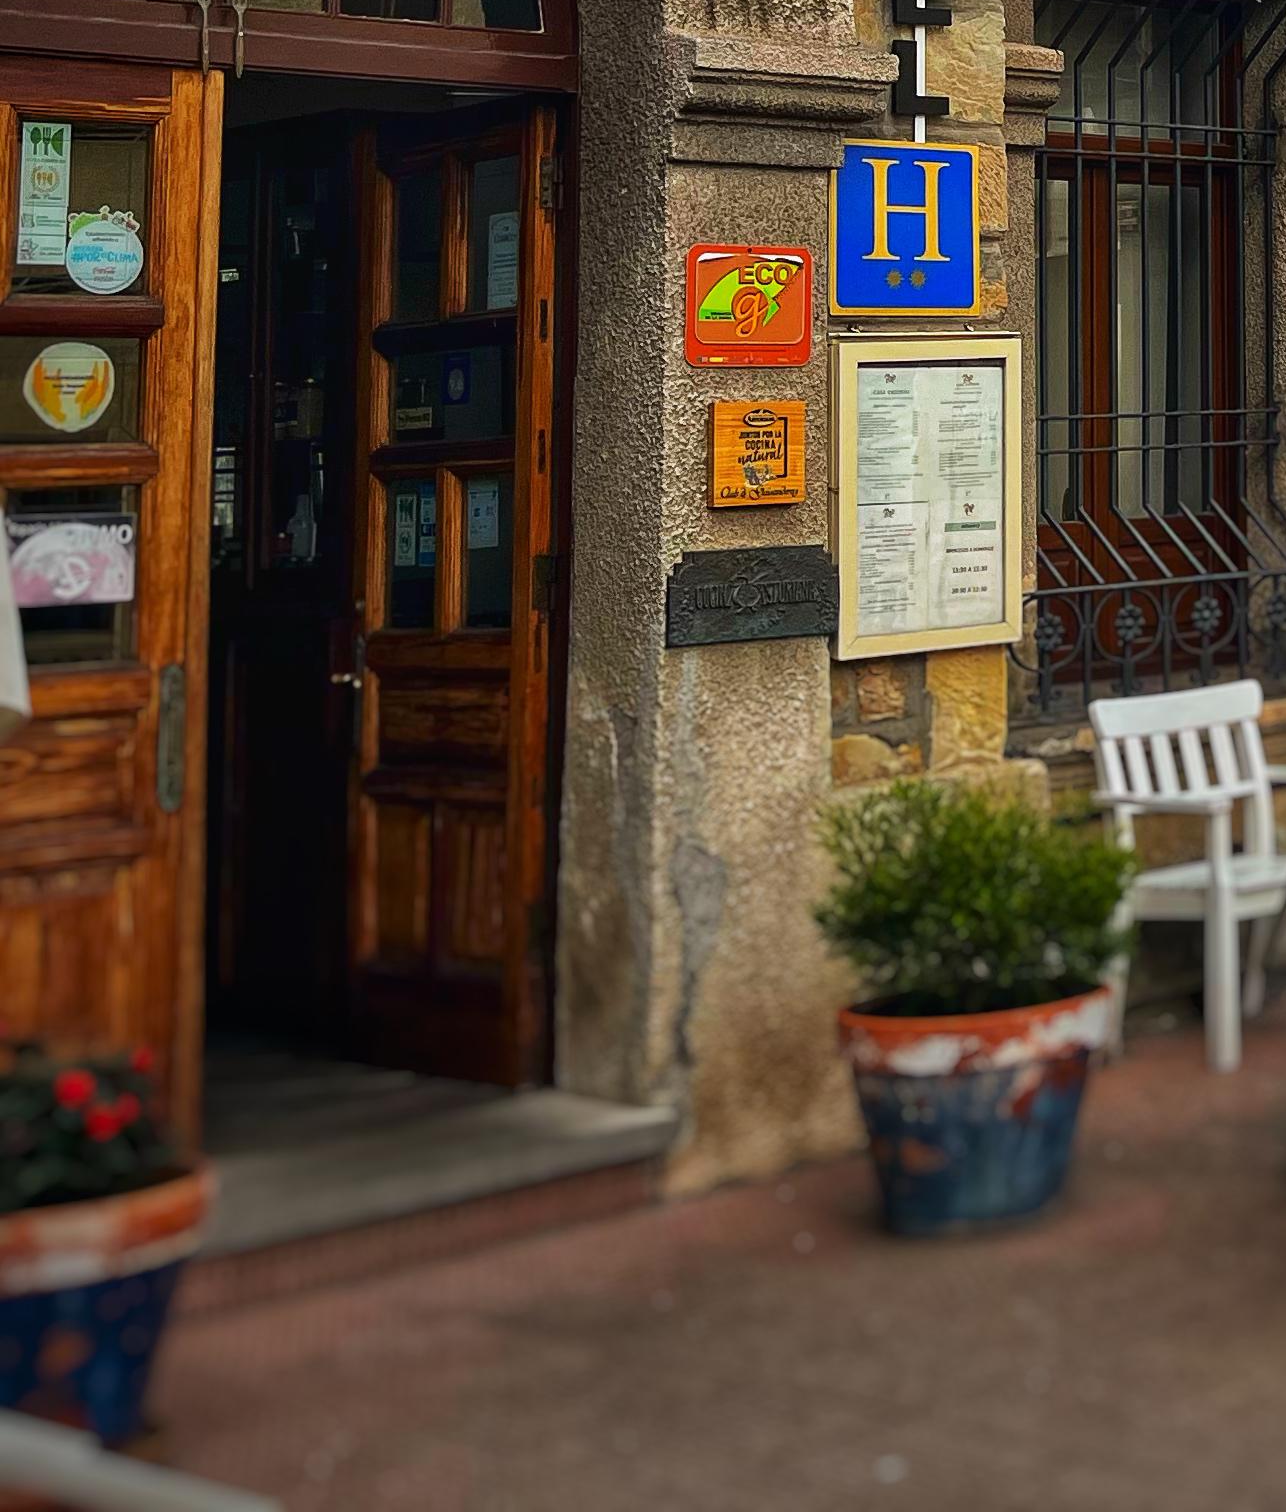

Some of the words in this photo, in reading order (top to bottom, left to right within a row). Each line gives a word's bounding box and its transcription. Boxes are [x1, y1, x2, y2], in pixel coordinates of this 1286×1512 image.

[861, 158, 951, 262] H
[738, 260, 793, 286] ECO
[745, 439, 776, 450] COCINA
